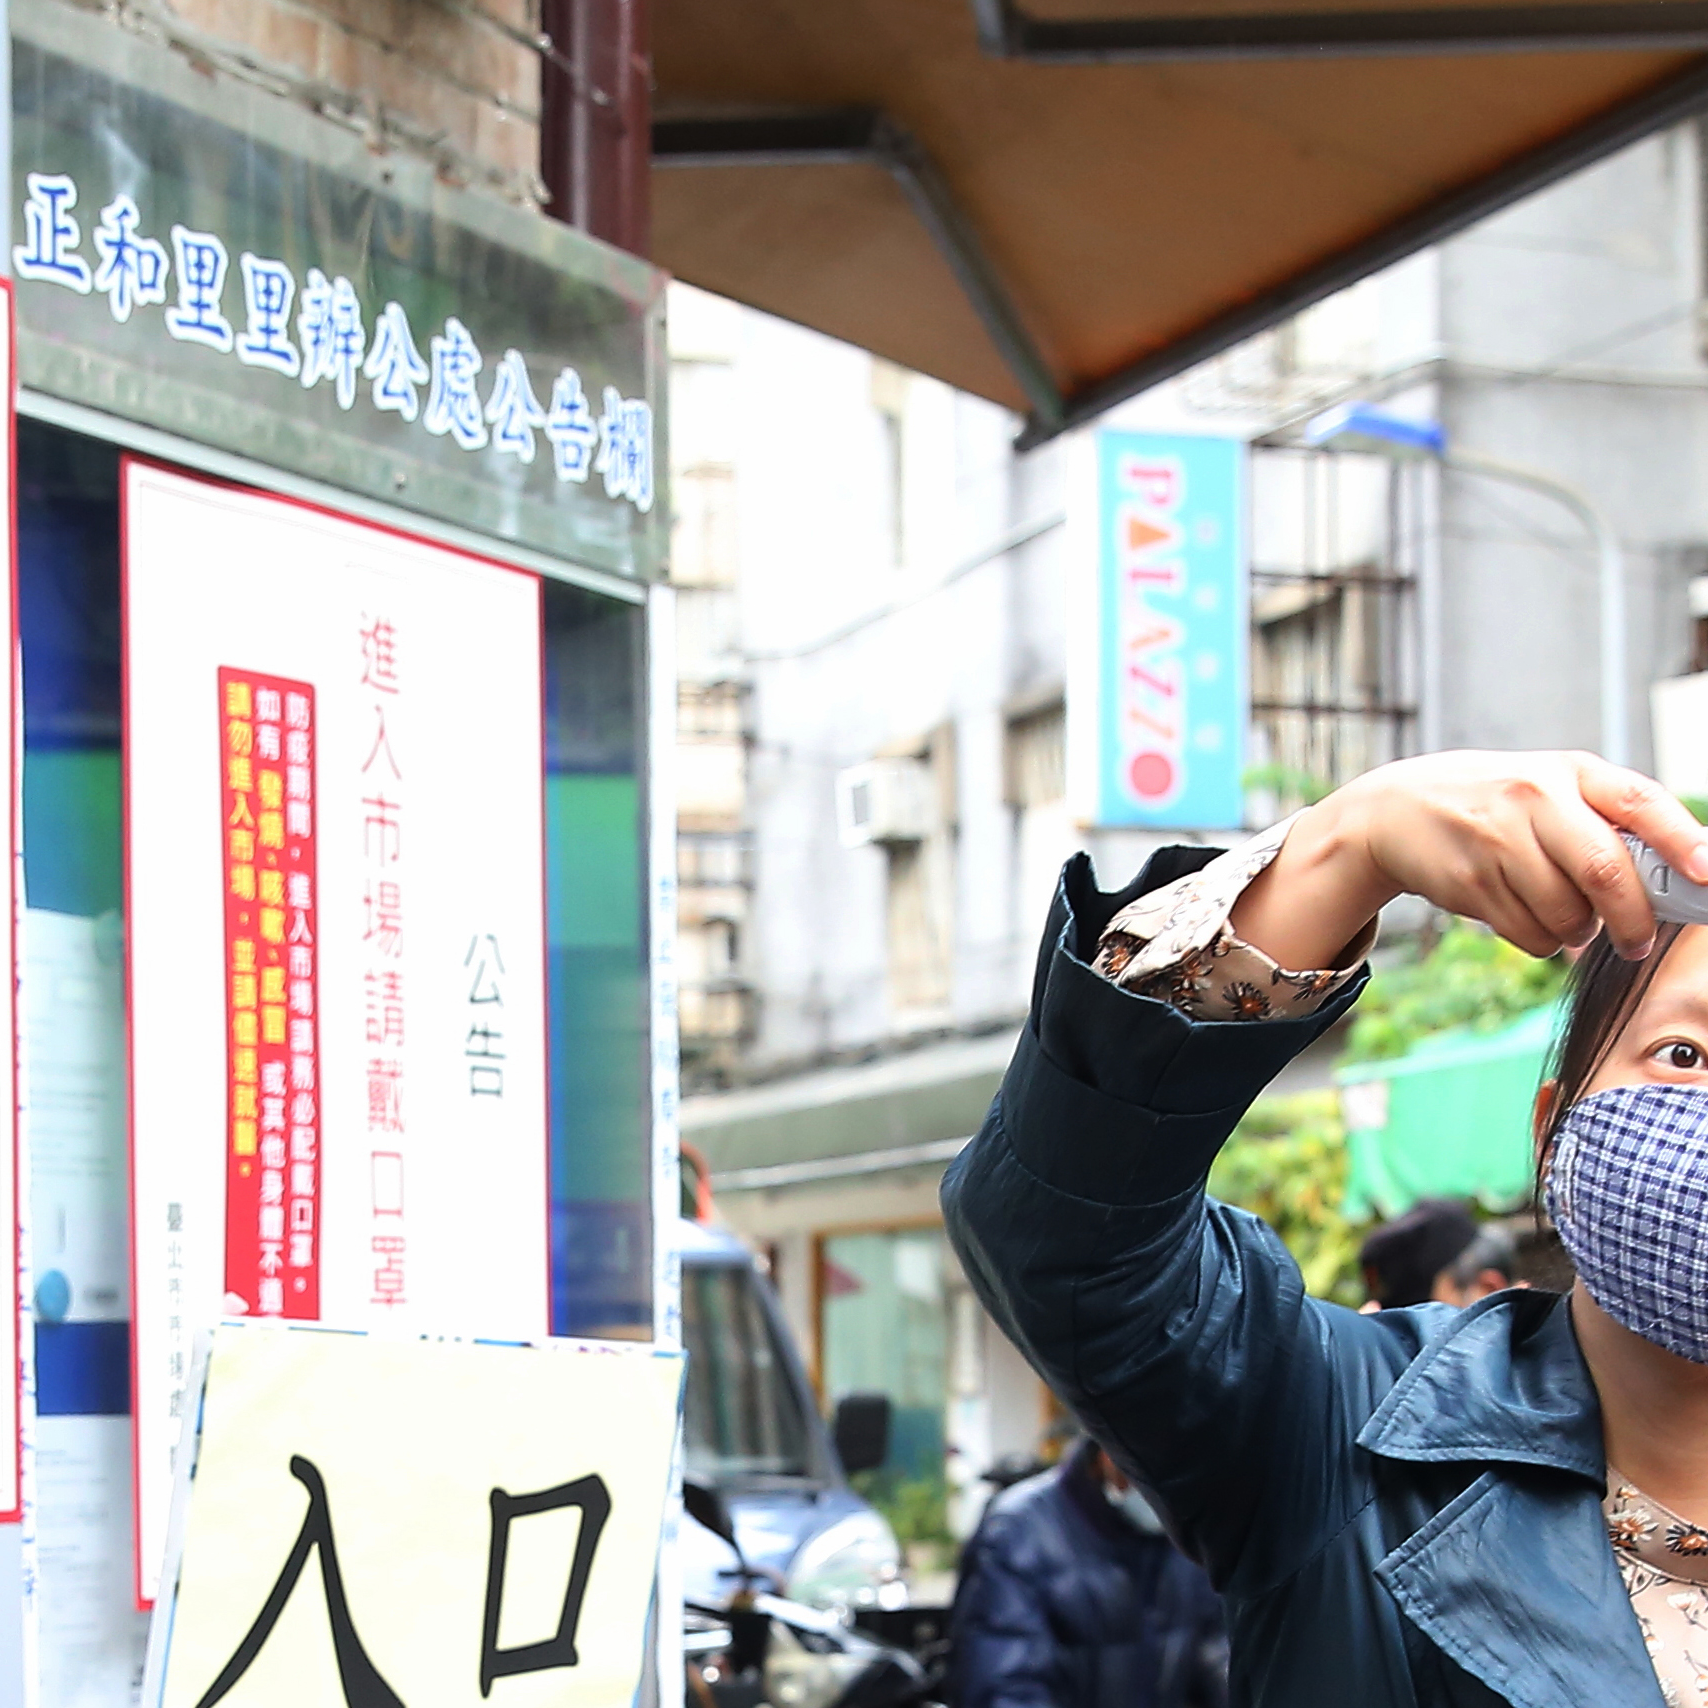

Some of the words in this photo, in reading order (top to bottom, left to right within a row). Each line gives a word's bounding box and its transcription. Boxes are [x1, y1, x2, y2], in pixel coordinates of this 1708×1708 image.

[15, 173, 653, 513] 正和里里辦公處公告欄
[464, 934, 506, 1097] 公告
